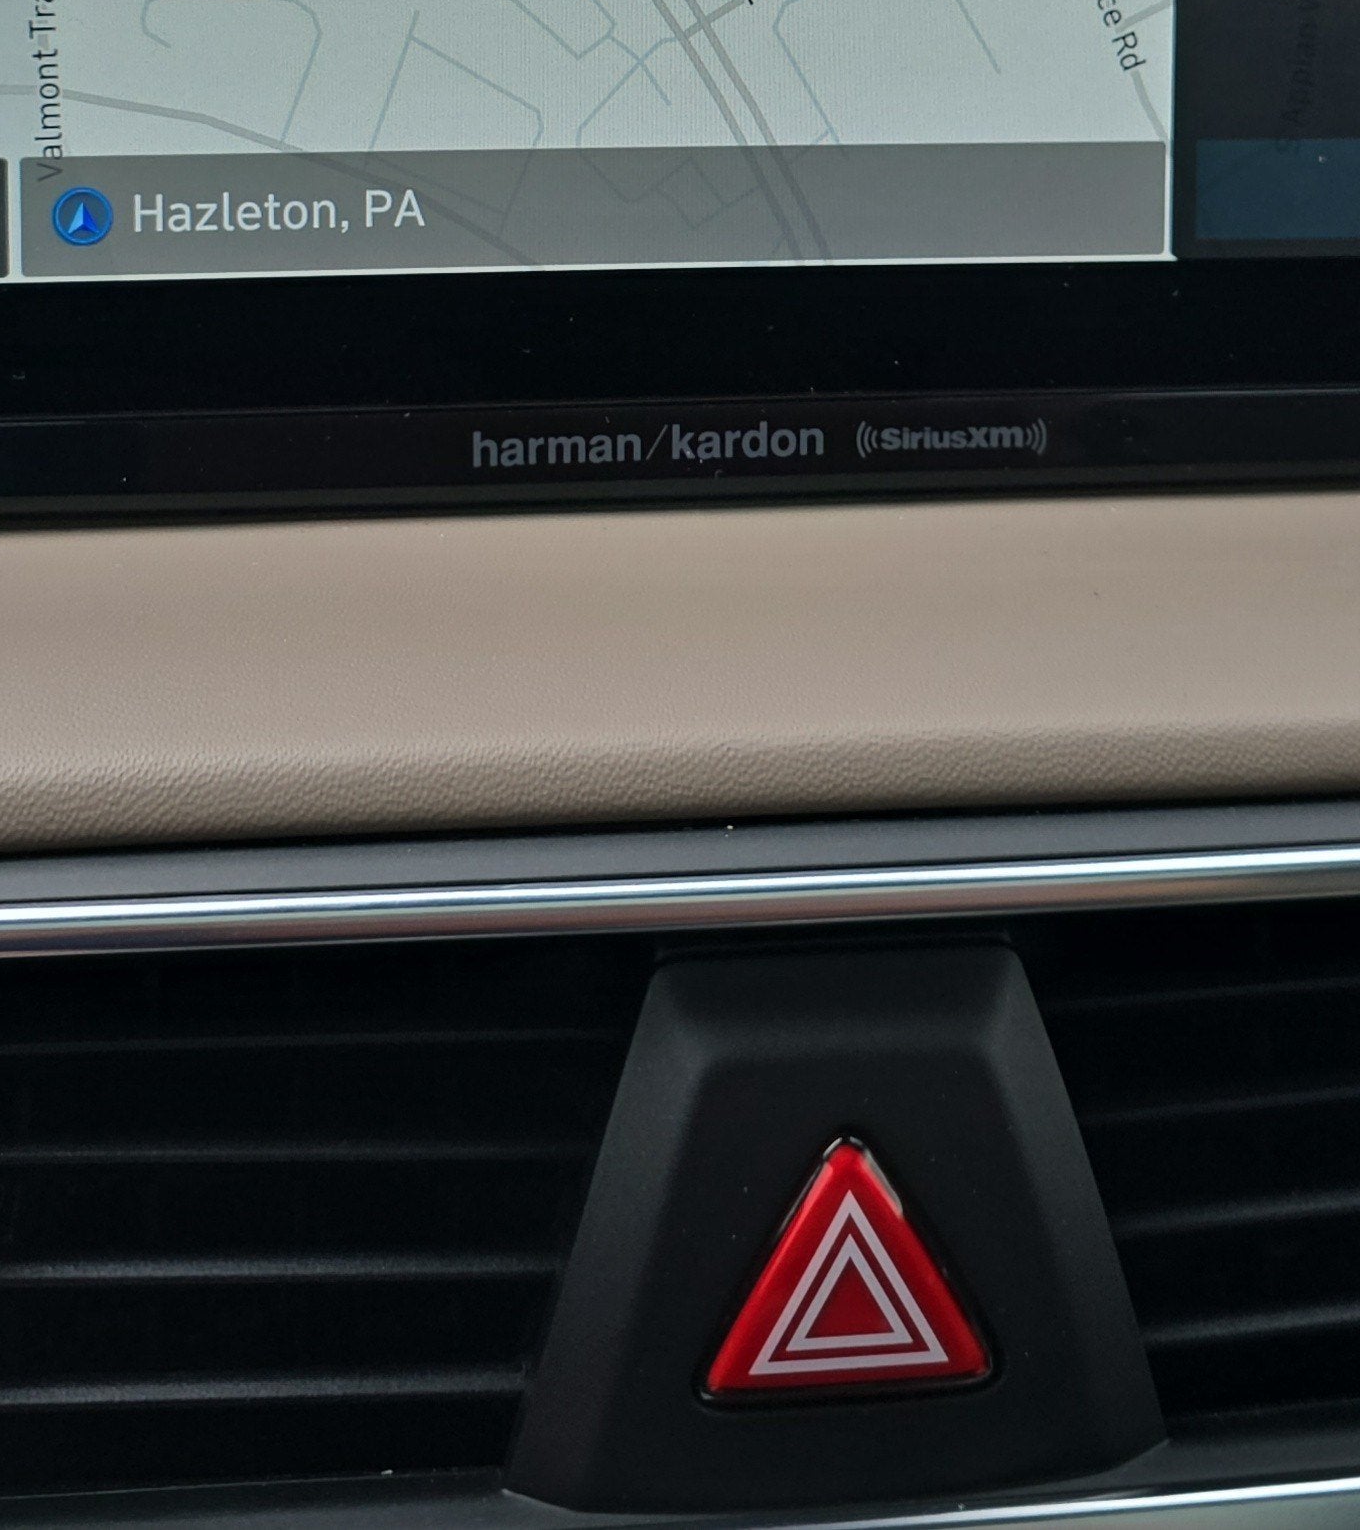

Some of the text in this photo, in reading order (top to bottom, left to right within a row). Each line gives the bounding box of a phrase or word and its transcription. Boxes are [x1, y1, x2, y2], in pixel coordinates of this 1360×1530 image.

[1110, 30, 1146, 73] Rd
[33, 43, 64, 183] Valmont
[133, 188, 426, 235] Hazleton, PA
